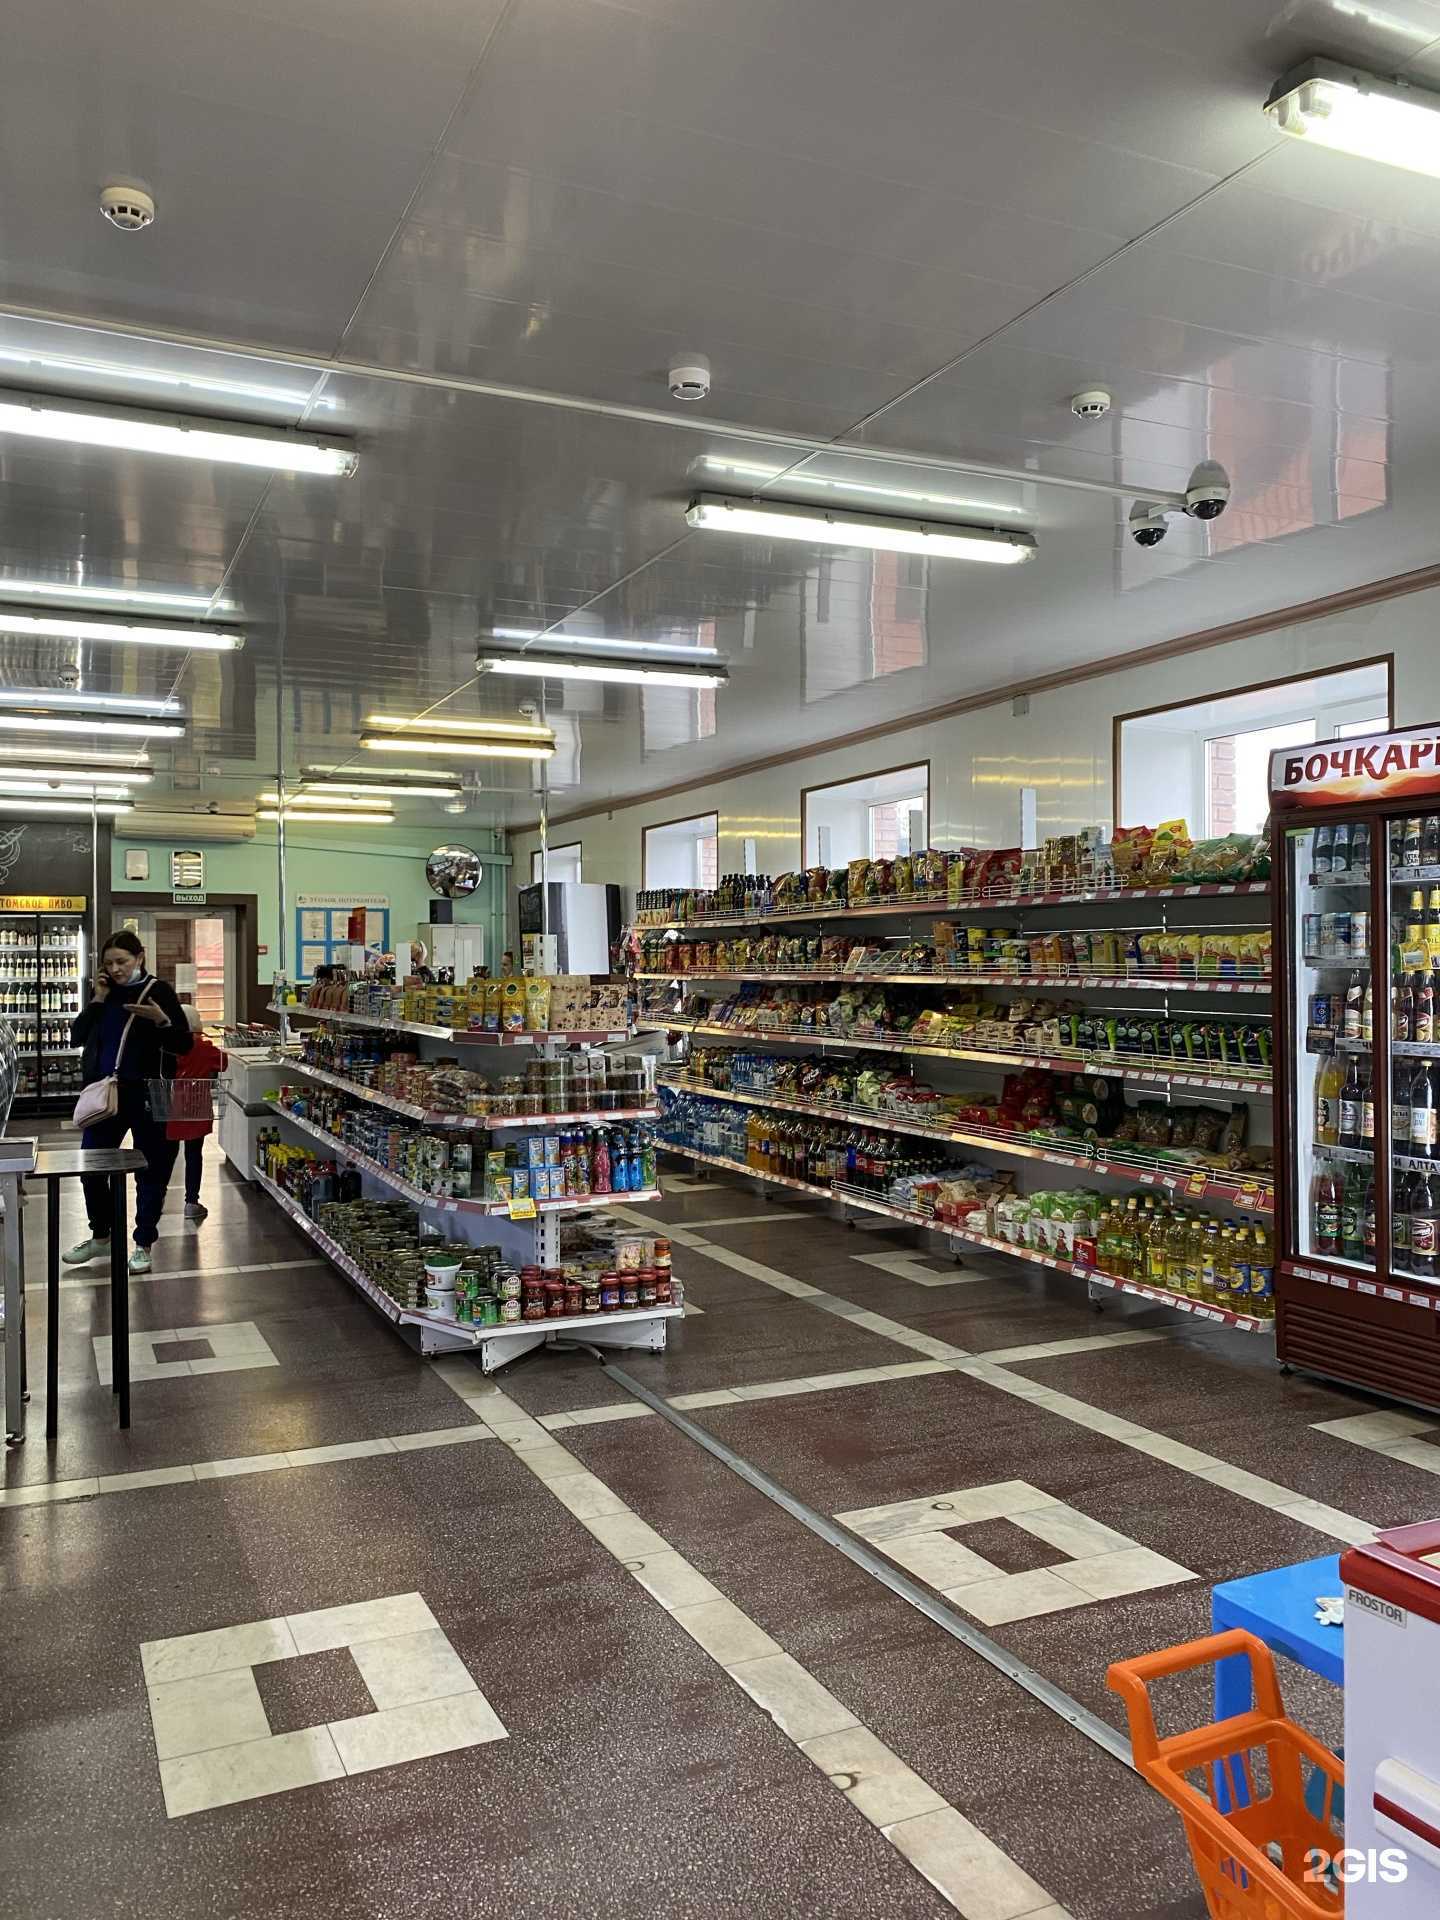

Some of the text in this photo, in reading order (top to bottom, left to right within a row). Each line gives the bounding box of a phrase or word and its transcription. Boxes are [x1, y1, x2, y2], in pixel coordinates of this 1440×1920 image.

[1284, 736, 1440, 785] БОЧКАР
[0, 898, 73, 909] ТОМСКОЕ ПИВО
[175, 894, 204, 902] ВЫХОД
[1349, 1589, 1402, 1622] FROSTOR
